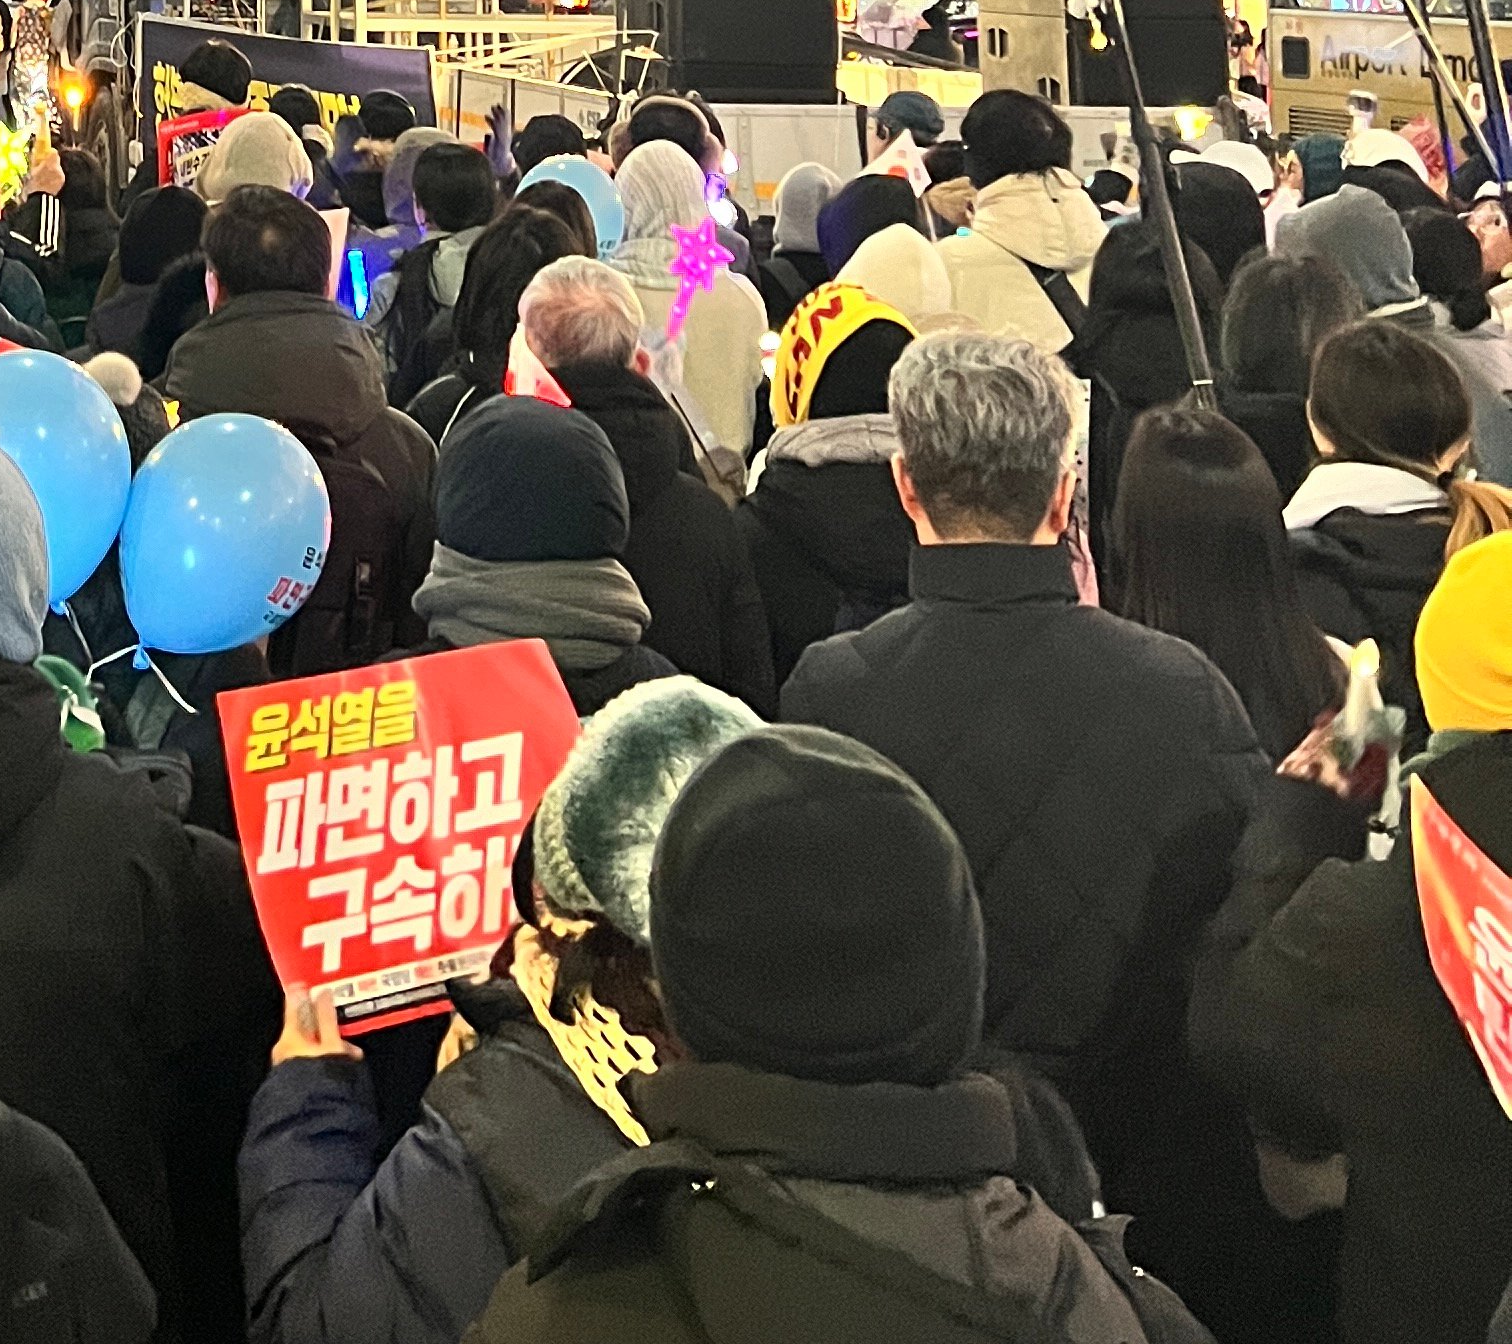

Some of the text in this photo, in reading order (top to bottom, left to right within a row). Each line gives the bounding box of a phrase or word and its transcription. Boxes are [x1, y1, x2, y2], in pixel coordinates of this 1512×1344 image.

[244, 679, 417, 773] 윤석열을
[255, 731, 524, 875] 파면하고
[301, 833, 520, 974] 구속하
